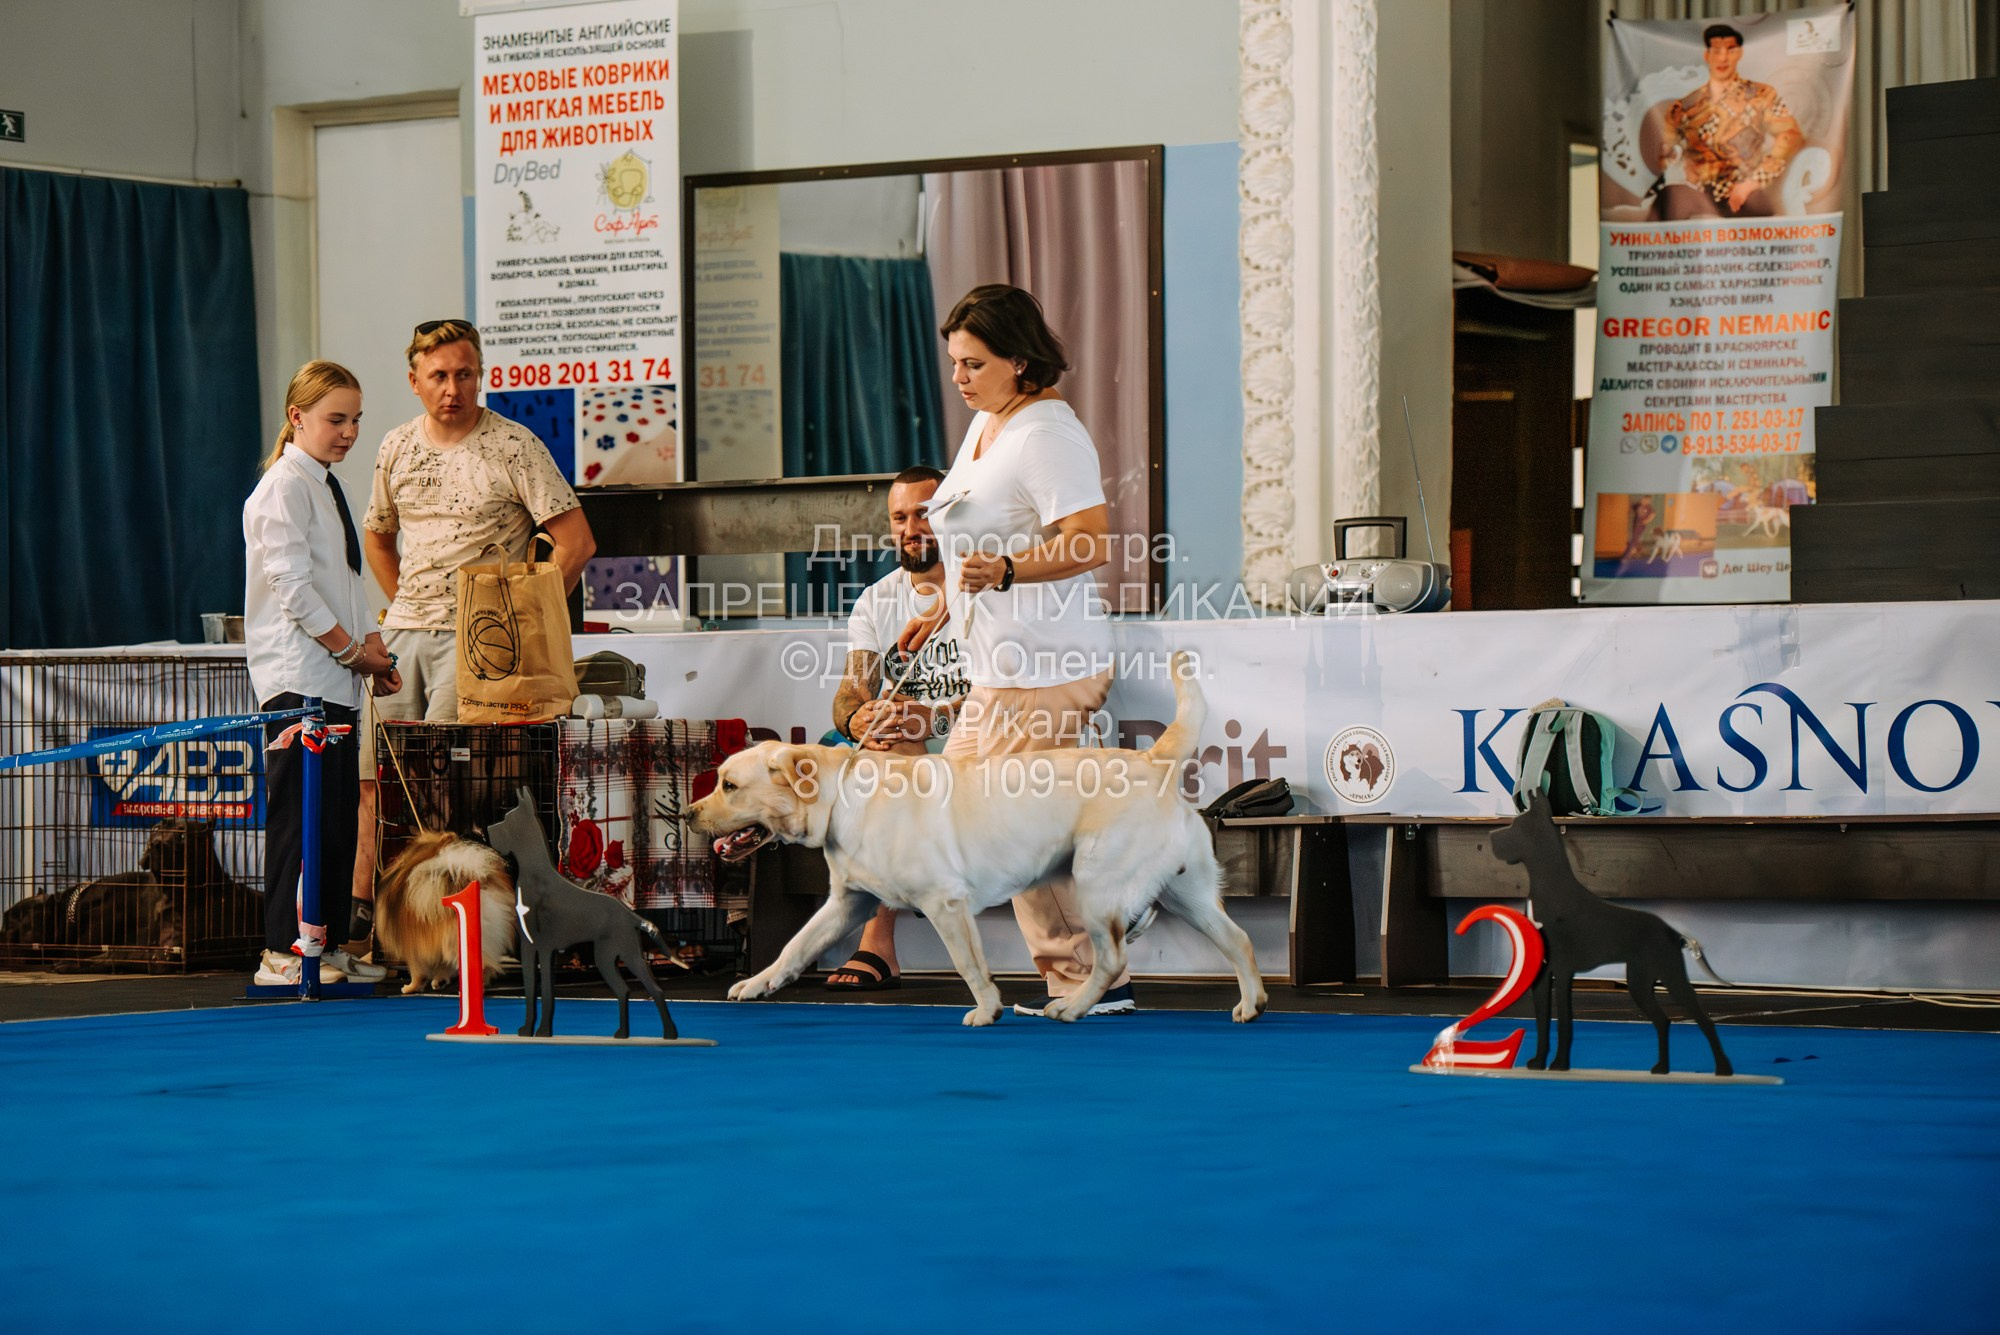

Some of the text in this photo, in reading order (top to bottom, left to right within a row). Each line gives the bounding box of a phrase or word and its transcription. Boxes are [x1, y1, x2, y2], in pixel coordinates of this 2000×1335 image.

[483, 18, 671, 50] ЗНАМЕНИТЫЕ АНГЛИЙСКИЕ
[488, 38, 666, 64] НА ГИБКОЙ НЕСКОЛЬЗЯЩЕЙ ОСНОВЕ
[483, 59, 670, 96] МЕХОВЫЕ КОВРИКИ
[490, 90, 665, 124] И МЯГКАЯ МЕБЕЛЬ
[500, 119, 653, 157] ДЛЯ ЖИВОТНЫХ
[494, 158, 562, 187] DryBed
[1610, 223, 1836, 247] УНИКАЛЬНАЯ ВОЗМОЖНОСТЬ
[496, 249, 664, 268] УНИВЕРСАЛЬНЫЕ КОВРИКИ ДЛЯ КЛЕТОК,
[1628, 247, 1702, 260] ТРИУМФАТОР
[1705, 246, 1765, 259] МИРОВЫХ
[491, 262, 668, 281] ВОЛЬЕРОВ, БОКСОВ, МАШИН, В КВАРТИРАХ
[1611, 262, 1680, 277] УСПЕШНЫЙ
[1619, 275, 1824, 293] ОДИН ИЗ САМЫХ ХАРИЗМАТИЧНЫХ
[578, 292, 635, 303] ПРОПУСКАЮТ
[637, 290, 664, 300] ЧЕРЕЗ
[1669, 294, 1773, 308] ХЭНДЛЕРОВ МИРА
[499, 304, 661, 321] СЕБЯ ВЛАГУ, ПОЗВОЛЯЯ ПОВЕРХНОСТИ
[480, 314, 678, 335] ОСТАВАТЬСЯ СУХОЙ, БЕЗОПАСНЫ, НЕ СКОЛЬЗЯТ
[1602, 310, 1831, 338] GREGOR NEMANIC
[484, 328, 675, 346] НА ПОВЕРХНОСТИ, ПОГЛОЩАЮТ НЕПРИЯТНЫЕ
[1640, 339, 1798, 355] ПРОВОДИТ В КРАСНОЯРСКЕ
[558, 345, 583, 355] ЛЕГКО
[490, 357, 672, 388] 8 908 201 31 74
[1627, 361, 1724, 373] МАСТЕР-КЛАССЫ
[1728, 361, 1735, 370] И
[1600, 372, 1827, 391] ДЕЛИТСЯ СВОИМИ ИСКЛЮЧИТЕЛЬНЫМИ
[1644, 393, 1787, 408] СЕКРЕТАМИ МАСТЕРСТВА
[1622, 408, 1804, 433] ЗАПИСЬ ПО Т. 251-03-17
[1682, 432, 1801, 455] 8-913-534-03-17
[1450, 682, 2000, 811] KASNO
[443, 880, 498, 1036] 1
[1422, 904, 1546, 1070] 2
